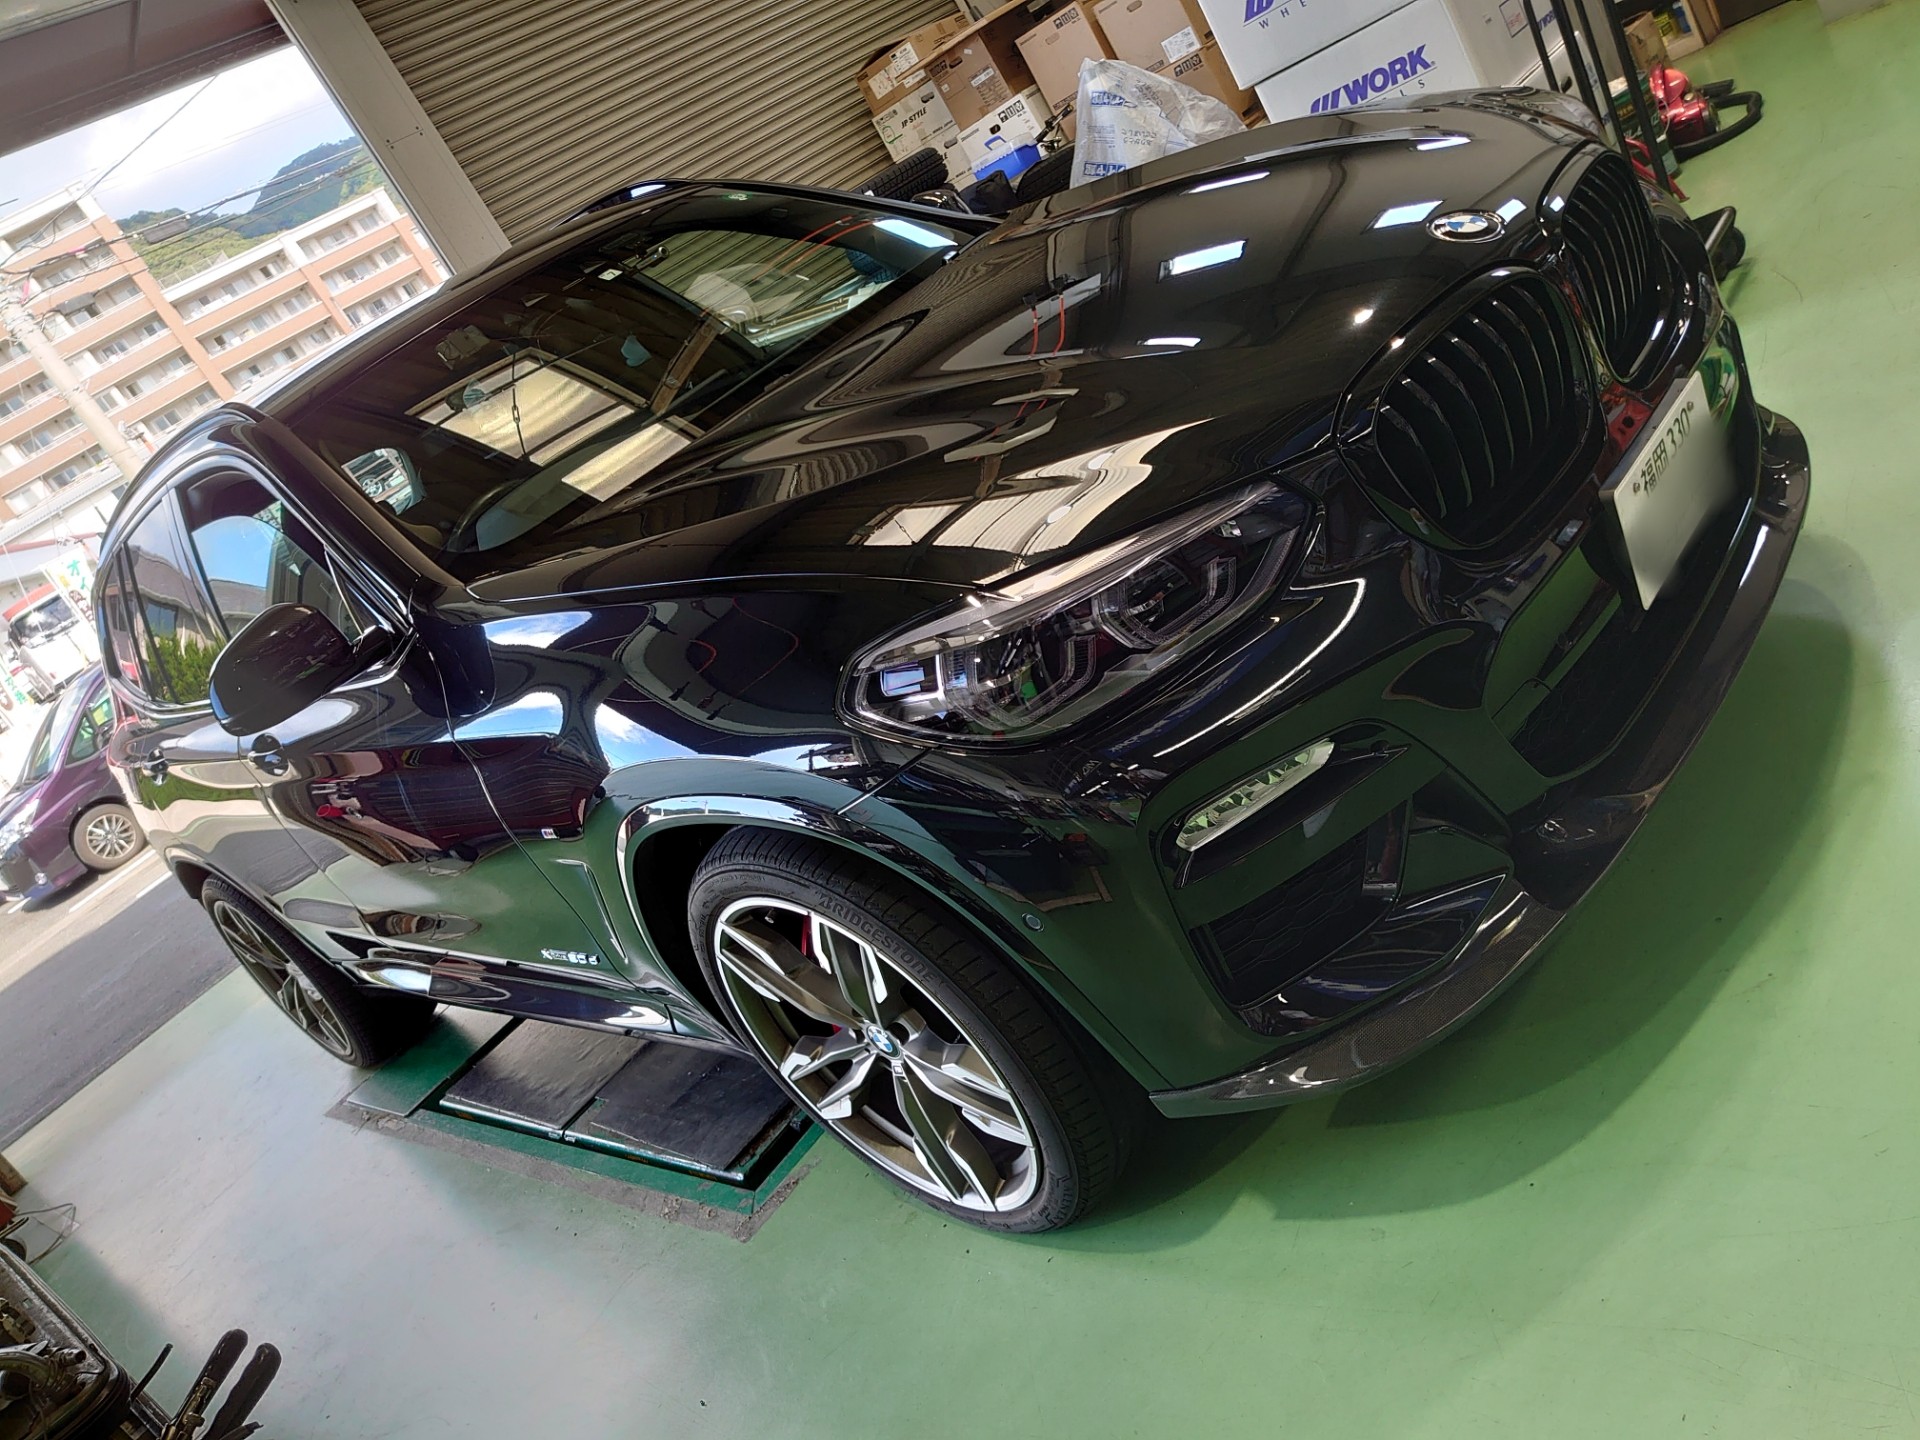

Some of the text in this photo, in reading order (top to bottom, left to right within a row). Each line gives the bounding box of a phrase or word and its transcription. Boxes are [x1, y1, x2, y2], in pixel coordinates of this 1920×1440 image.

[1342, 44, 1432, 105] WORK
[908, 106, 927, 124] STYLE
[1666, 408, 1691, 457] 330
[819, 892, 938, 983] BRIDGESTONE
